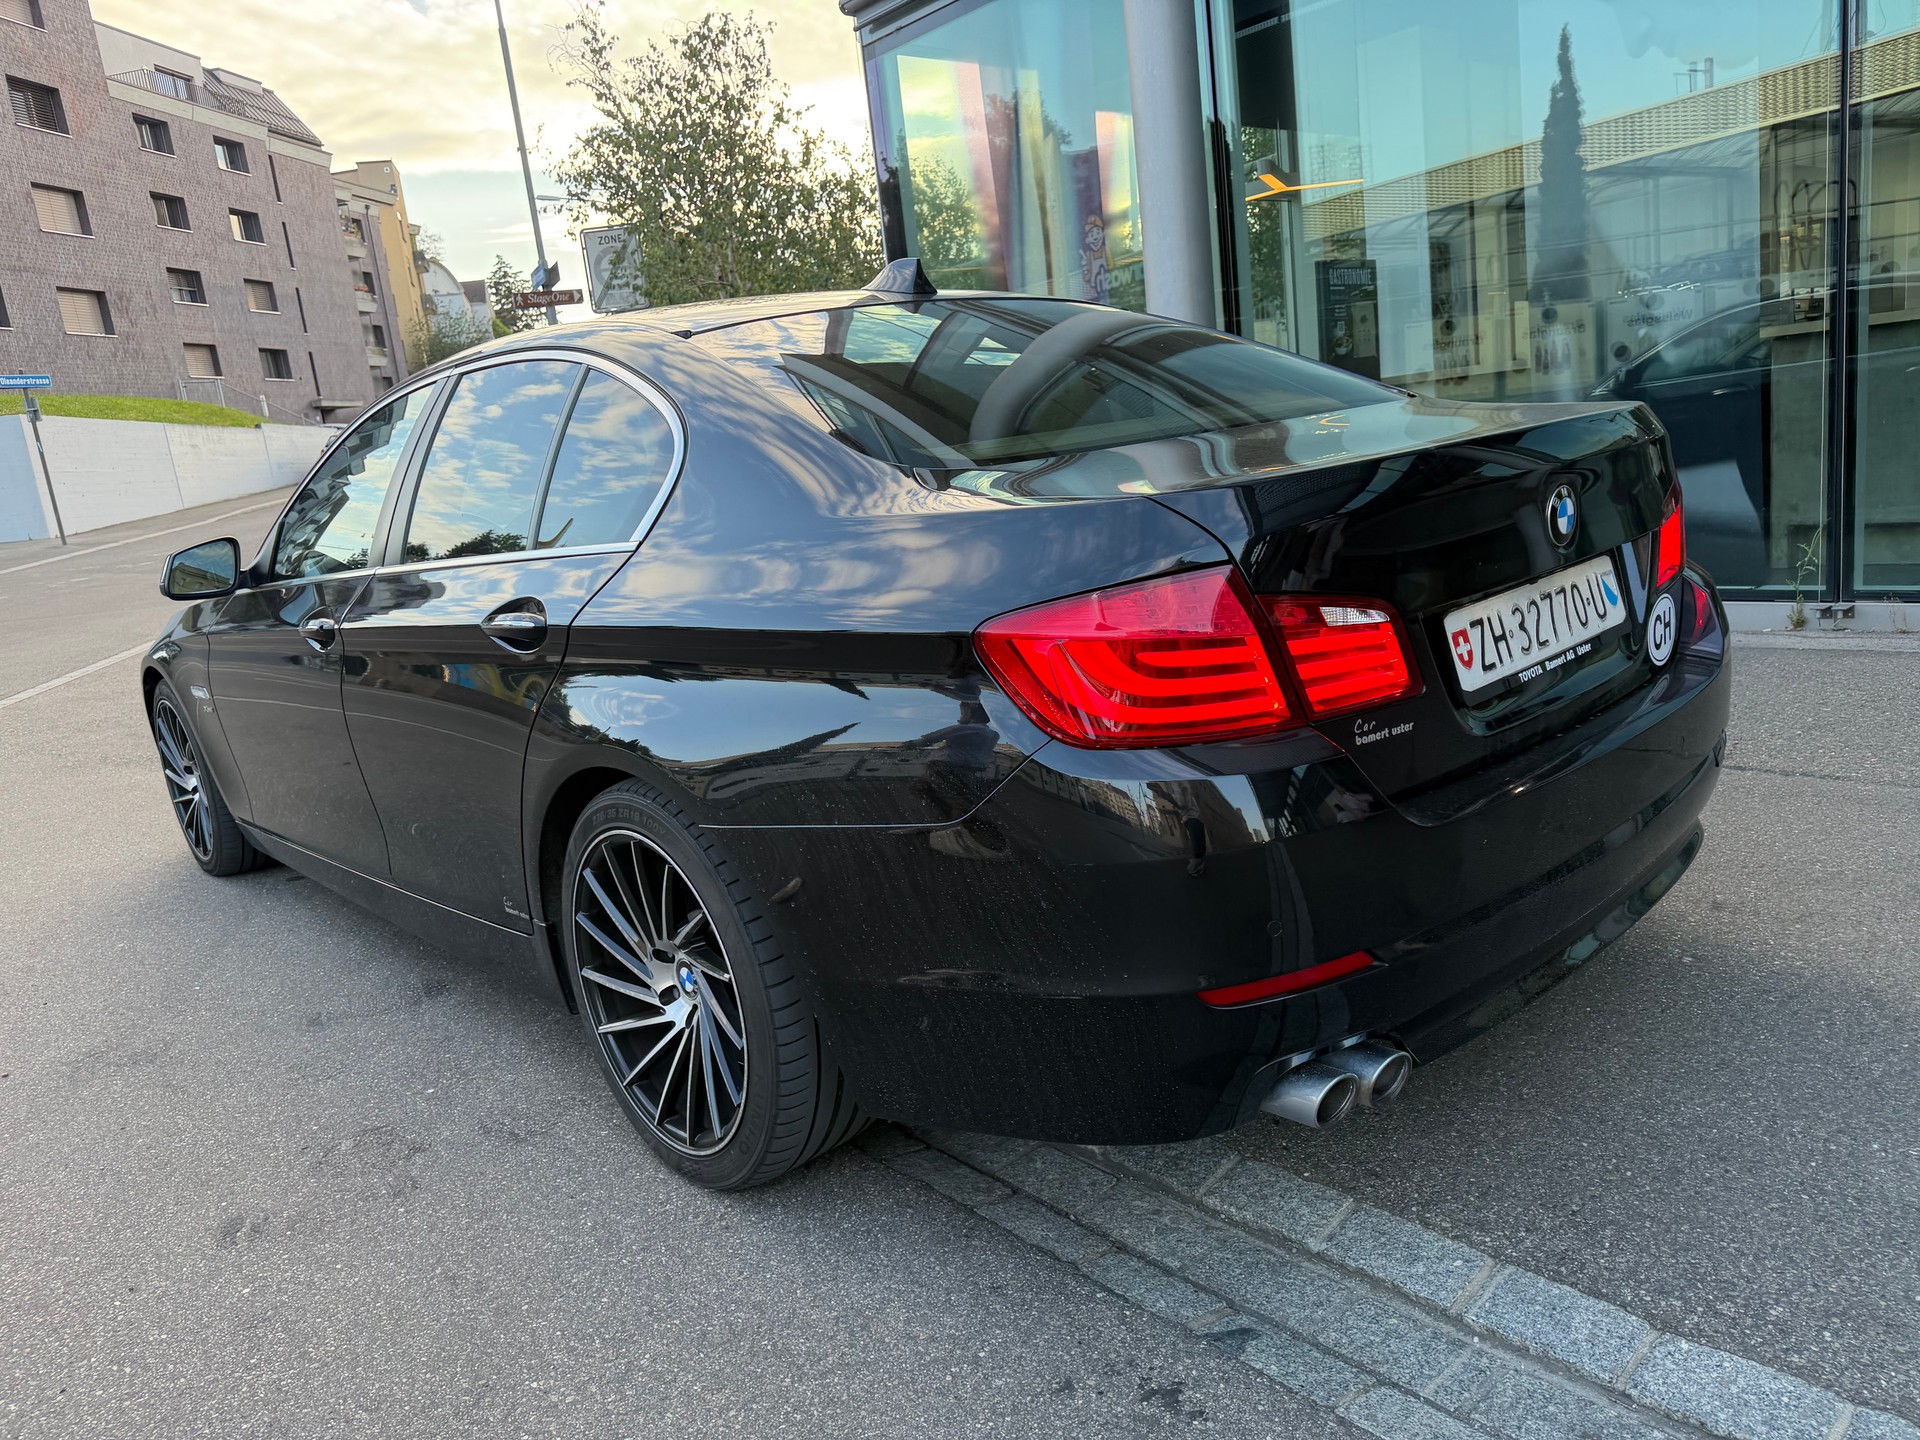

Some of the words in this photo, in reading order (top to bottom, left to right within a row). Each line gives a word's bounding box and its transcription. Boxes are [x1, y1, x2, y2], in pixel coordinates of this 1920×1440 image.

[597, 233, 625, 246] ZONE
[1328, 268, 1371, 285] GASTRONOMIE
[527, 291, 570, 304] StageOne
[1653, 606, 1672, 651] CH
[1518, 664, 1544, 683] TOYOTA
[1544, 654, 1566, 671] Bamert
[1566, 649, 1575, 662] AG
[1576, 643, 1592, 656] Uster
[1354, 718, 1376, 733] Car
[1355, 727, 1389, 746] bamert
[1391, 721, 1415, 736] uster
